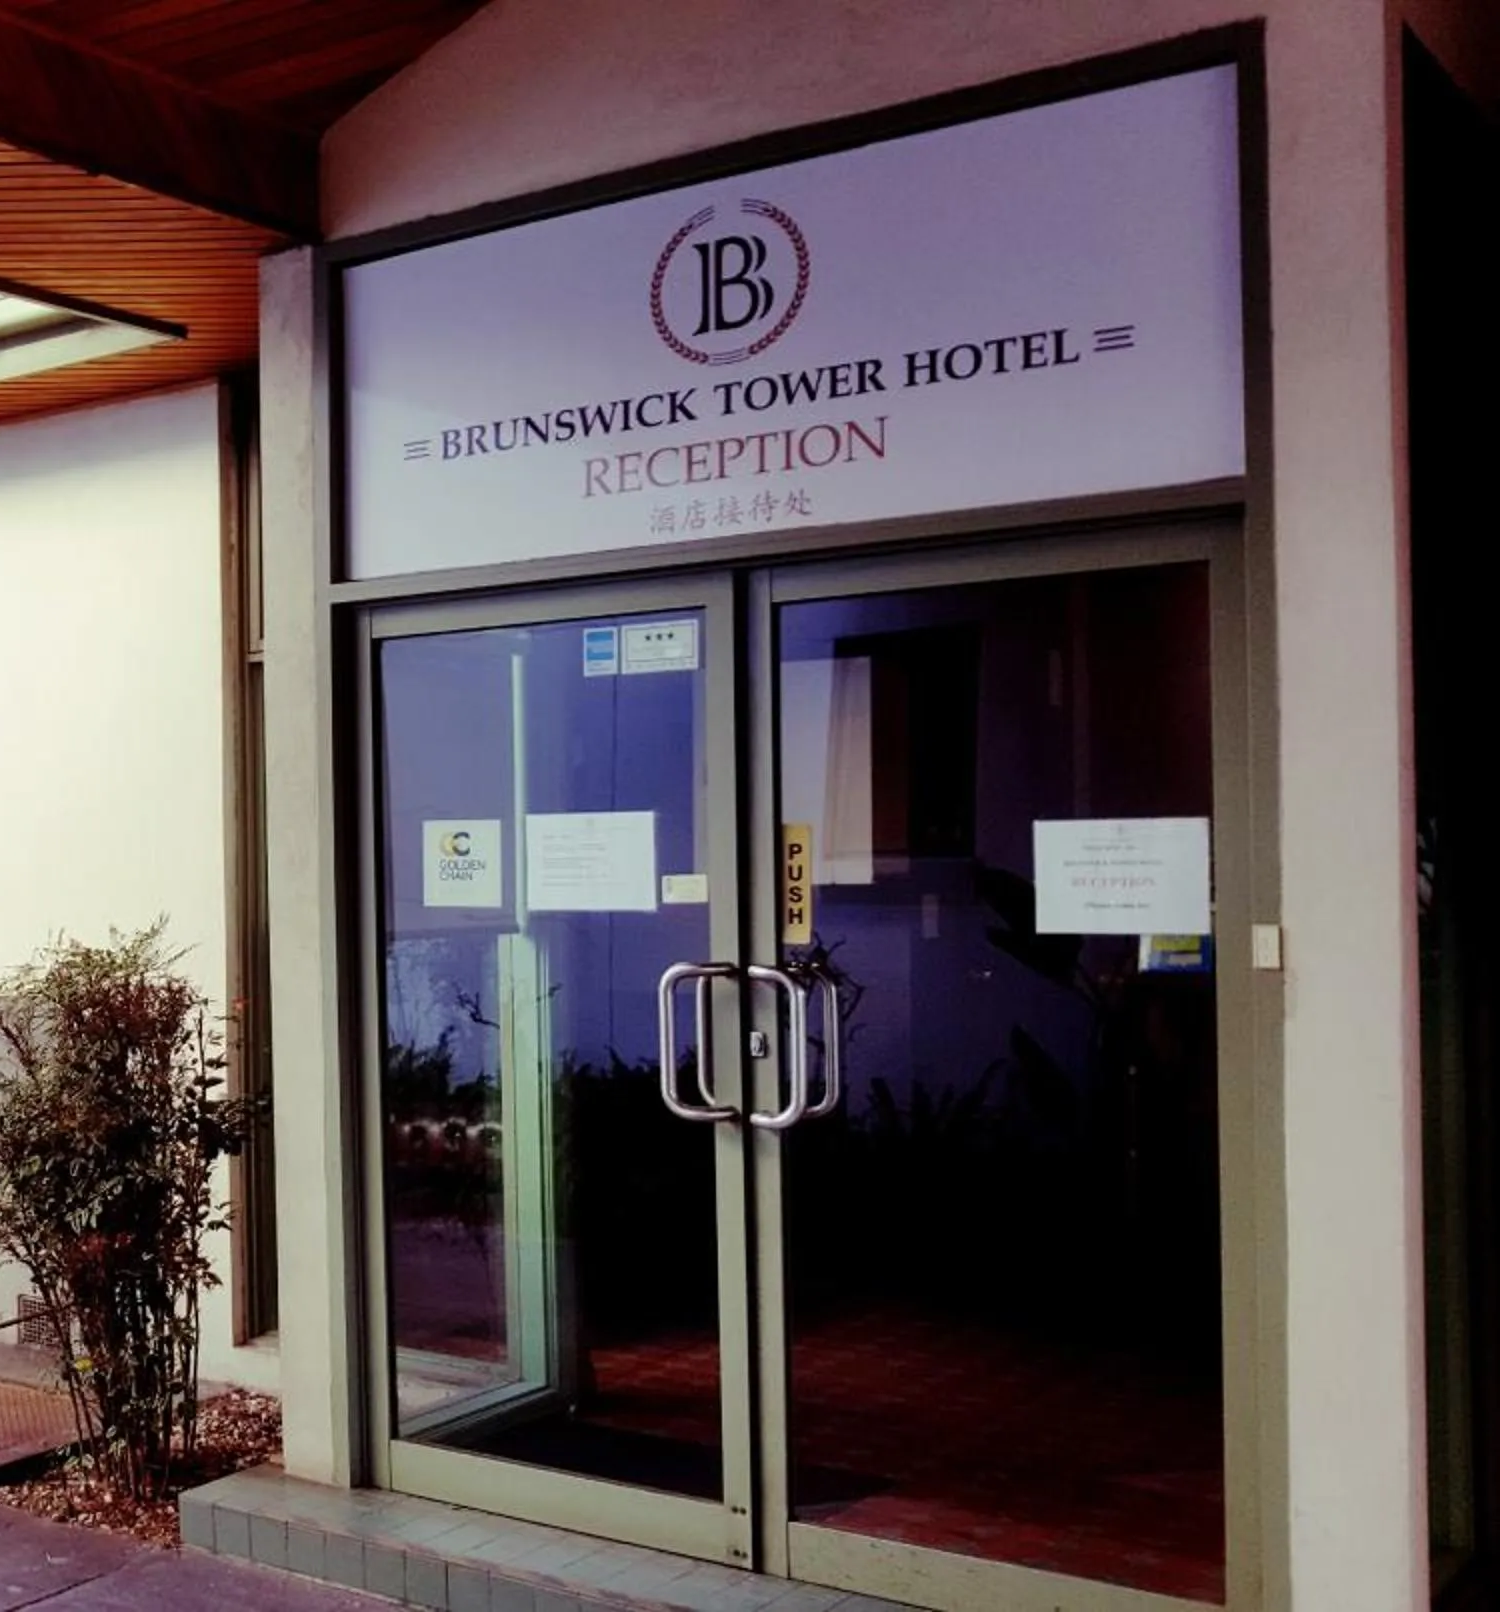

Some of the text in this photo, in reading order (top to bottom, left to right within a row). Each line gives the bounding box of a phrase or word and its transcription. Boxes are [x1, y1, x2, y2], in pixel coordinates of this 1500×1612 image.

[441, 328, 1080, 460] BRUNSWICK TOWER HOTEL
[581, 416, 889, 499] RECEPTION
[649, 489, 813, 534] 酒店接待处
[787, 843, 803, 925] PUSH
